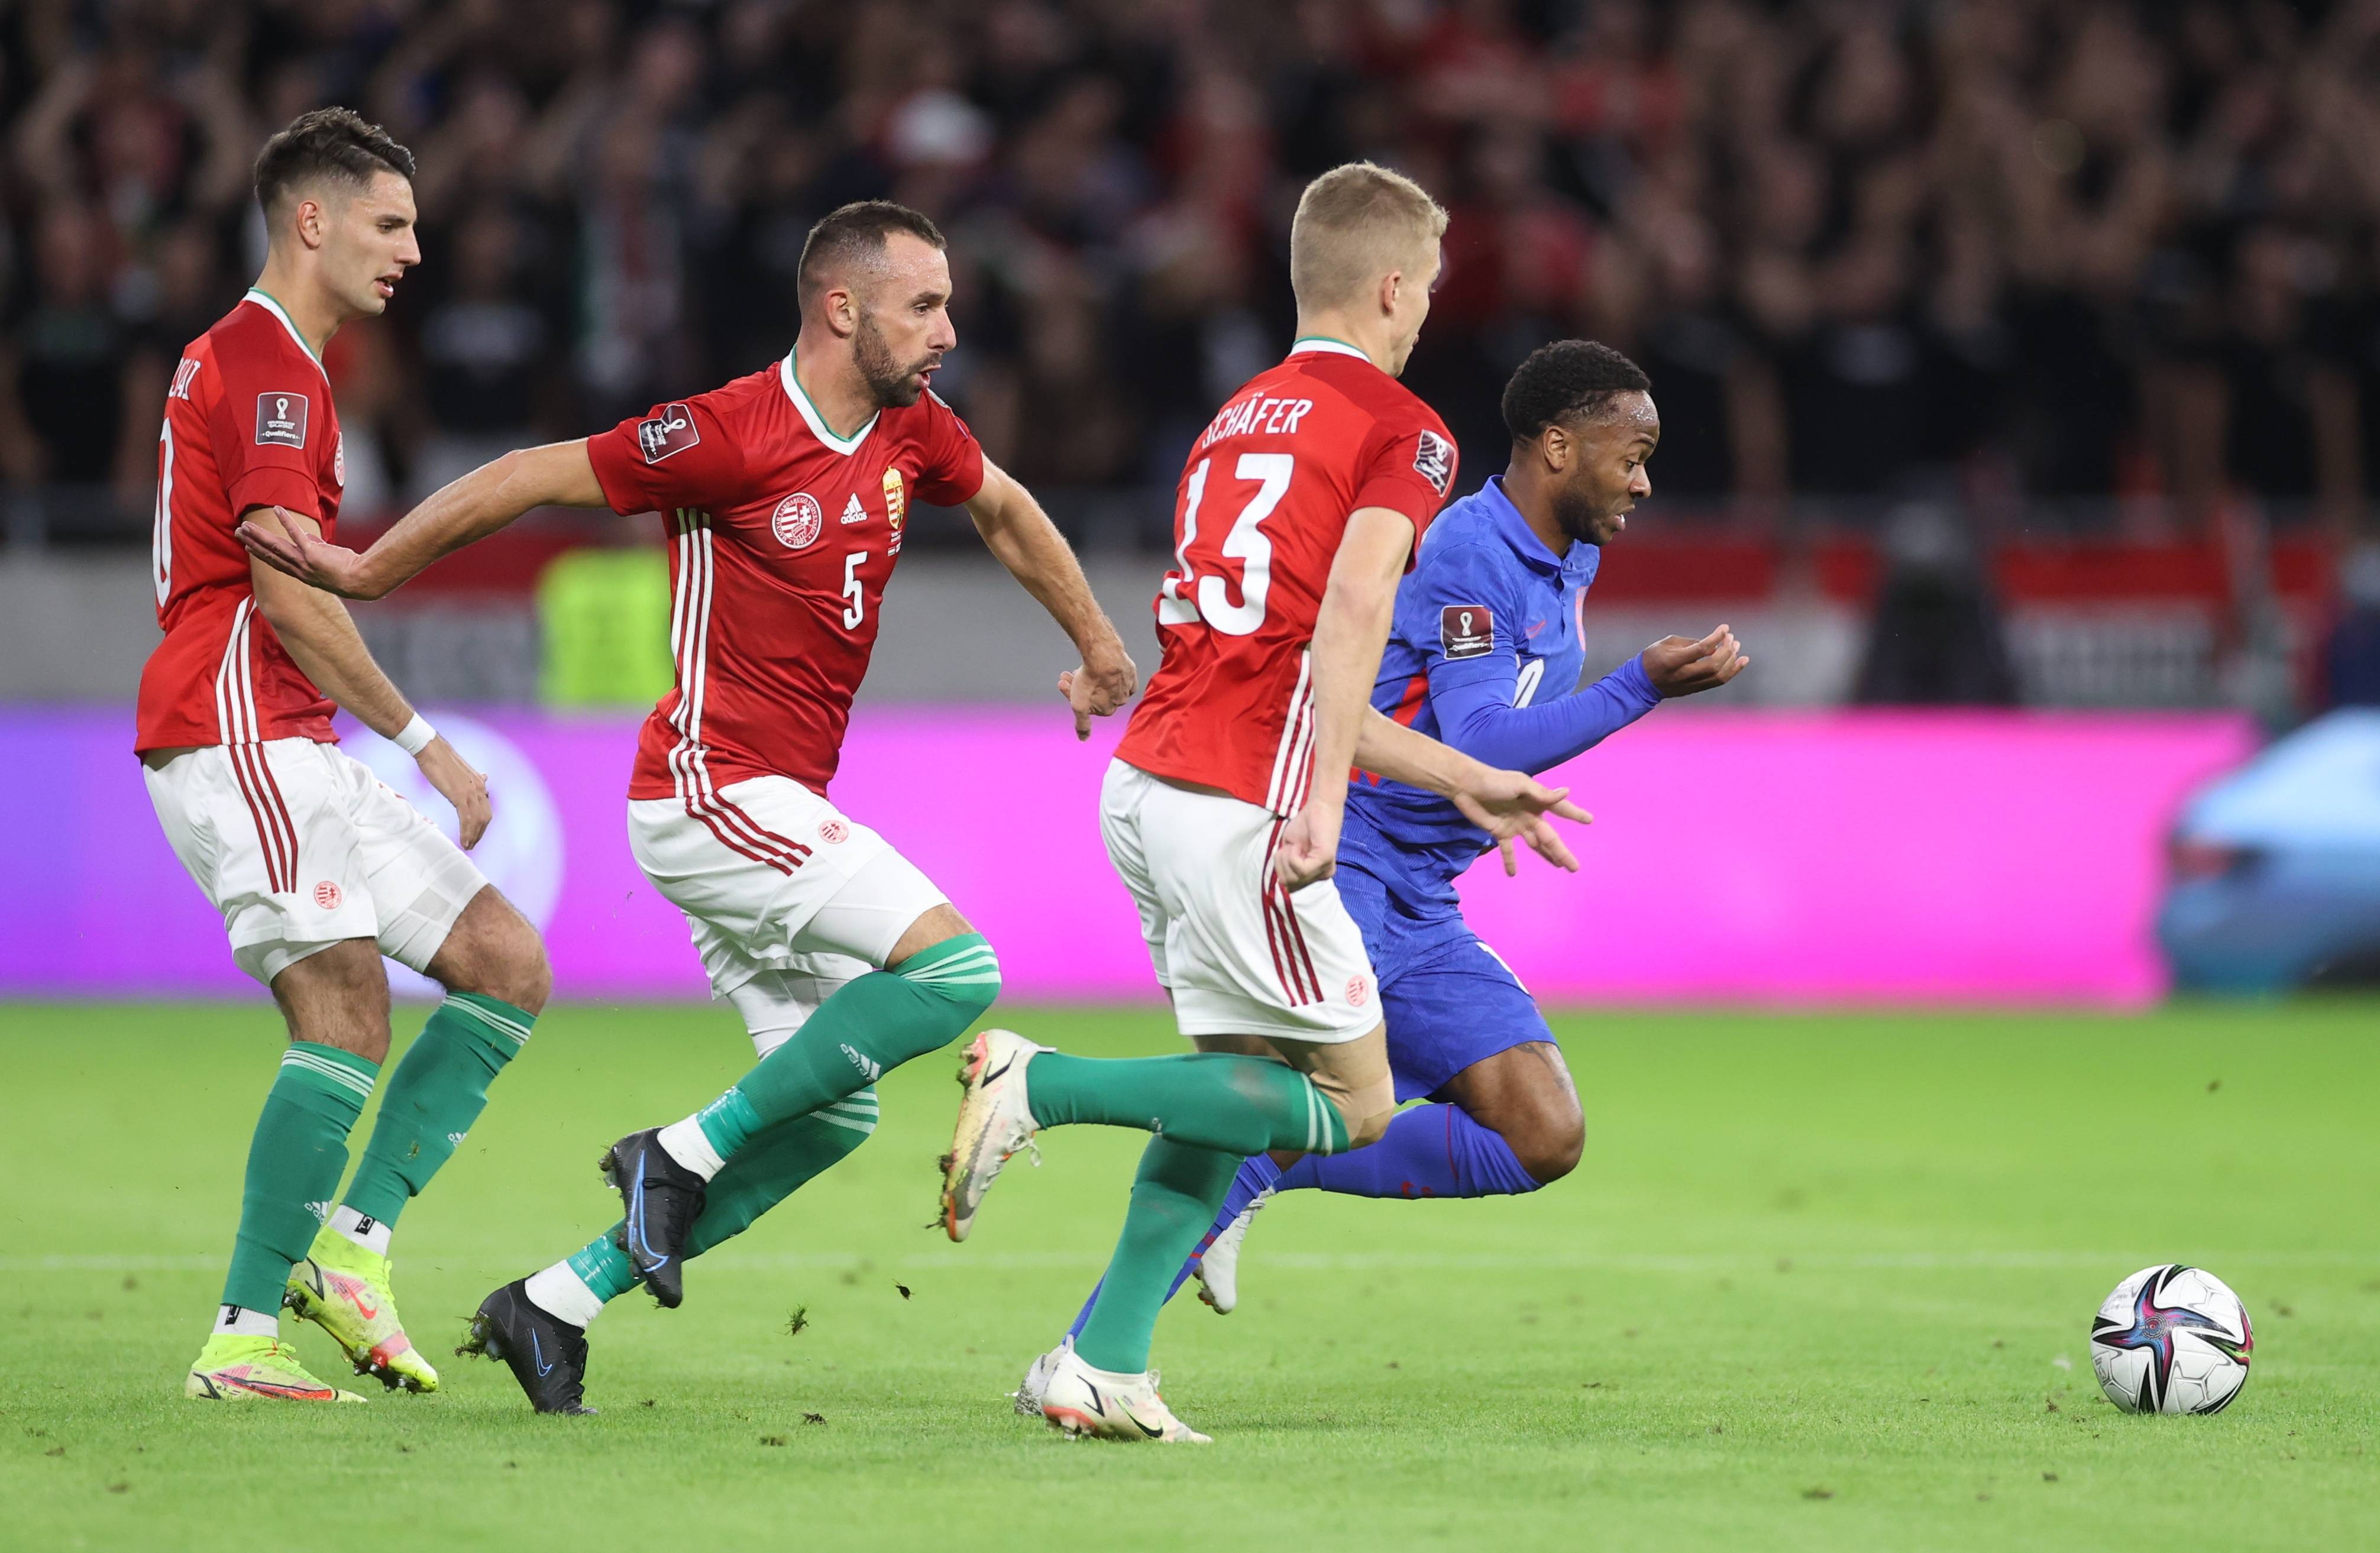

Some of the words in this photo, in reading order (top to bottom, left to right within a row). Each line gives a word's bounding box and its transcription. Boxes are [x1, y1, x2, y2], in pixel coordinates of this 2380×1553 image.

[265, 430, 296, 439] Qualifiers
[1202, 392, 1312, 449] SCHÄFER
[840, 511, 867, 525] adidas
[1159, 453, 1294, 635] 13
[842, 551, 868, 630] 5
